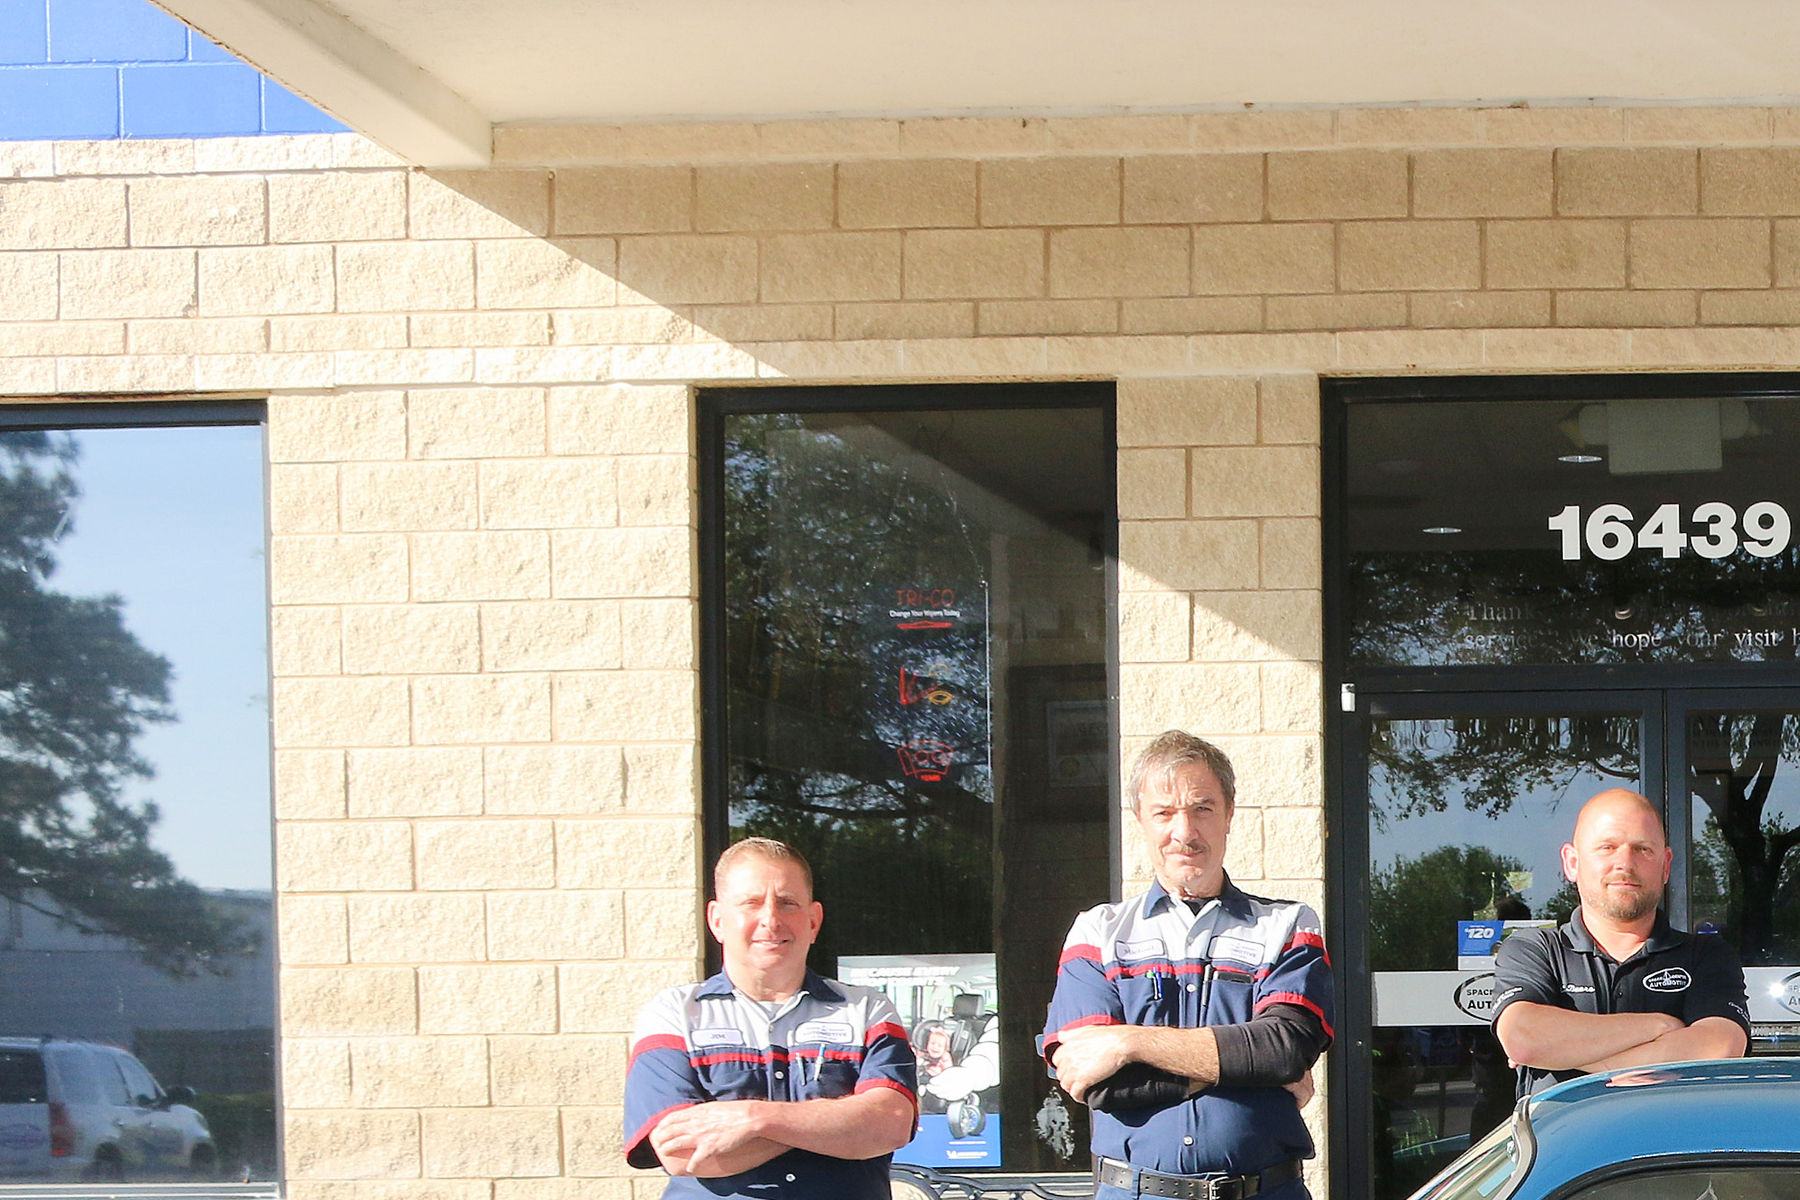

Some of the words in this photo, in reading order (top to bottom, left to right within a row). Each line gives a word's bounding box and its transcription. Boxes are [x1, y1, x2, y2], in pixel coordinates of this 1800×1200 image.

[1547, 501, 1792, 561] 16439
[1612, 629, 1662, 650] hope
[1734, 629, 1778, 647] visit
